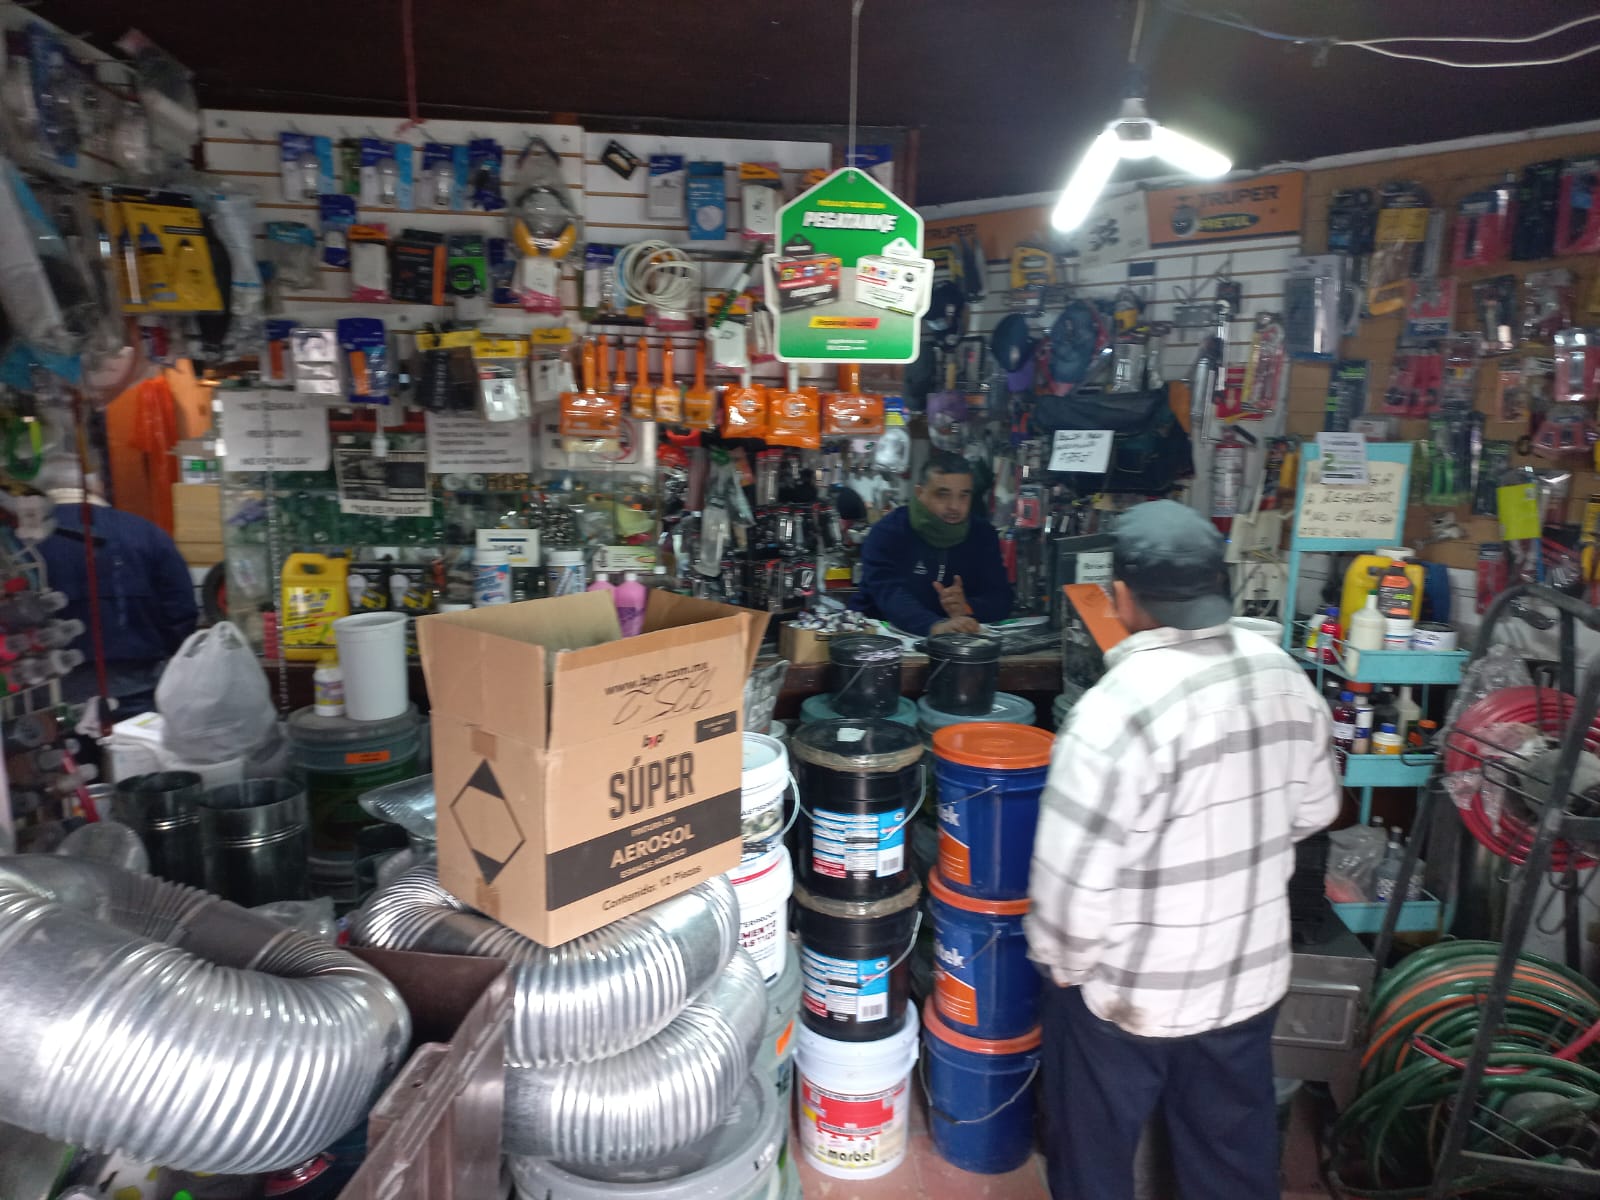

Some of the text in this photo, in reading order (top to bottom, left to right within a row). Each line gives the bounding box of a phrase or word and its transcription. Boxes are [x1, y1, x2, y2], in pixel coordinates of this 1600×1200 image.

[1198, 185, 1279, 208] TRUPER
[608, 752, 695, 820] SÚPER
[609, 824, 696, 868] AEROSOL
[828, 1148, 876, 1162] marbel
